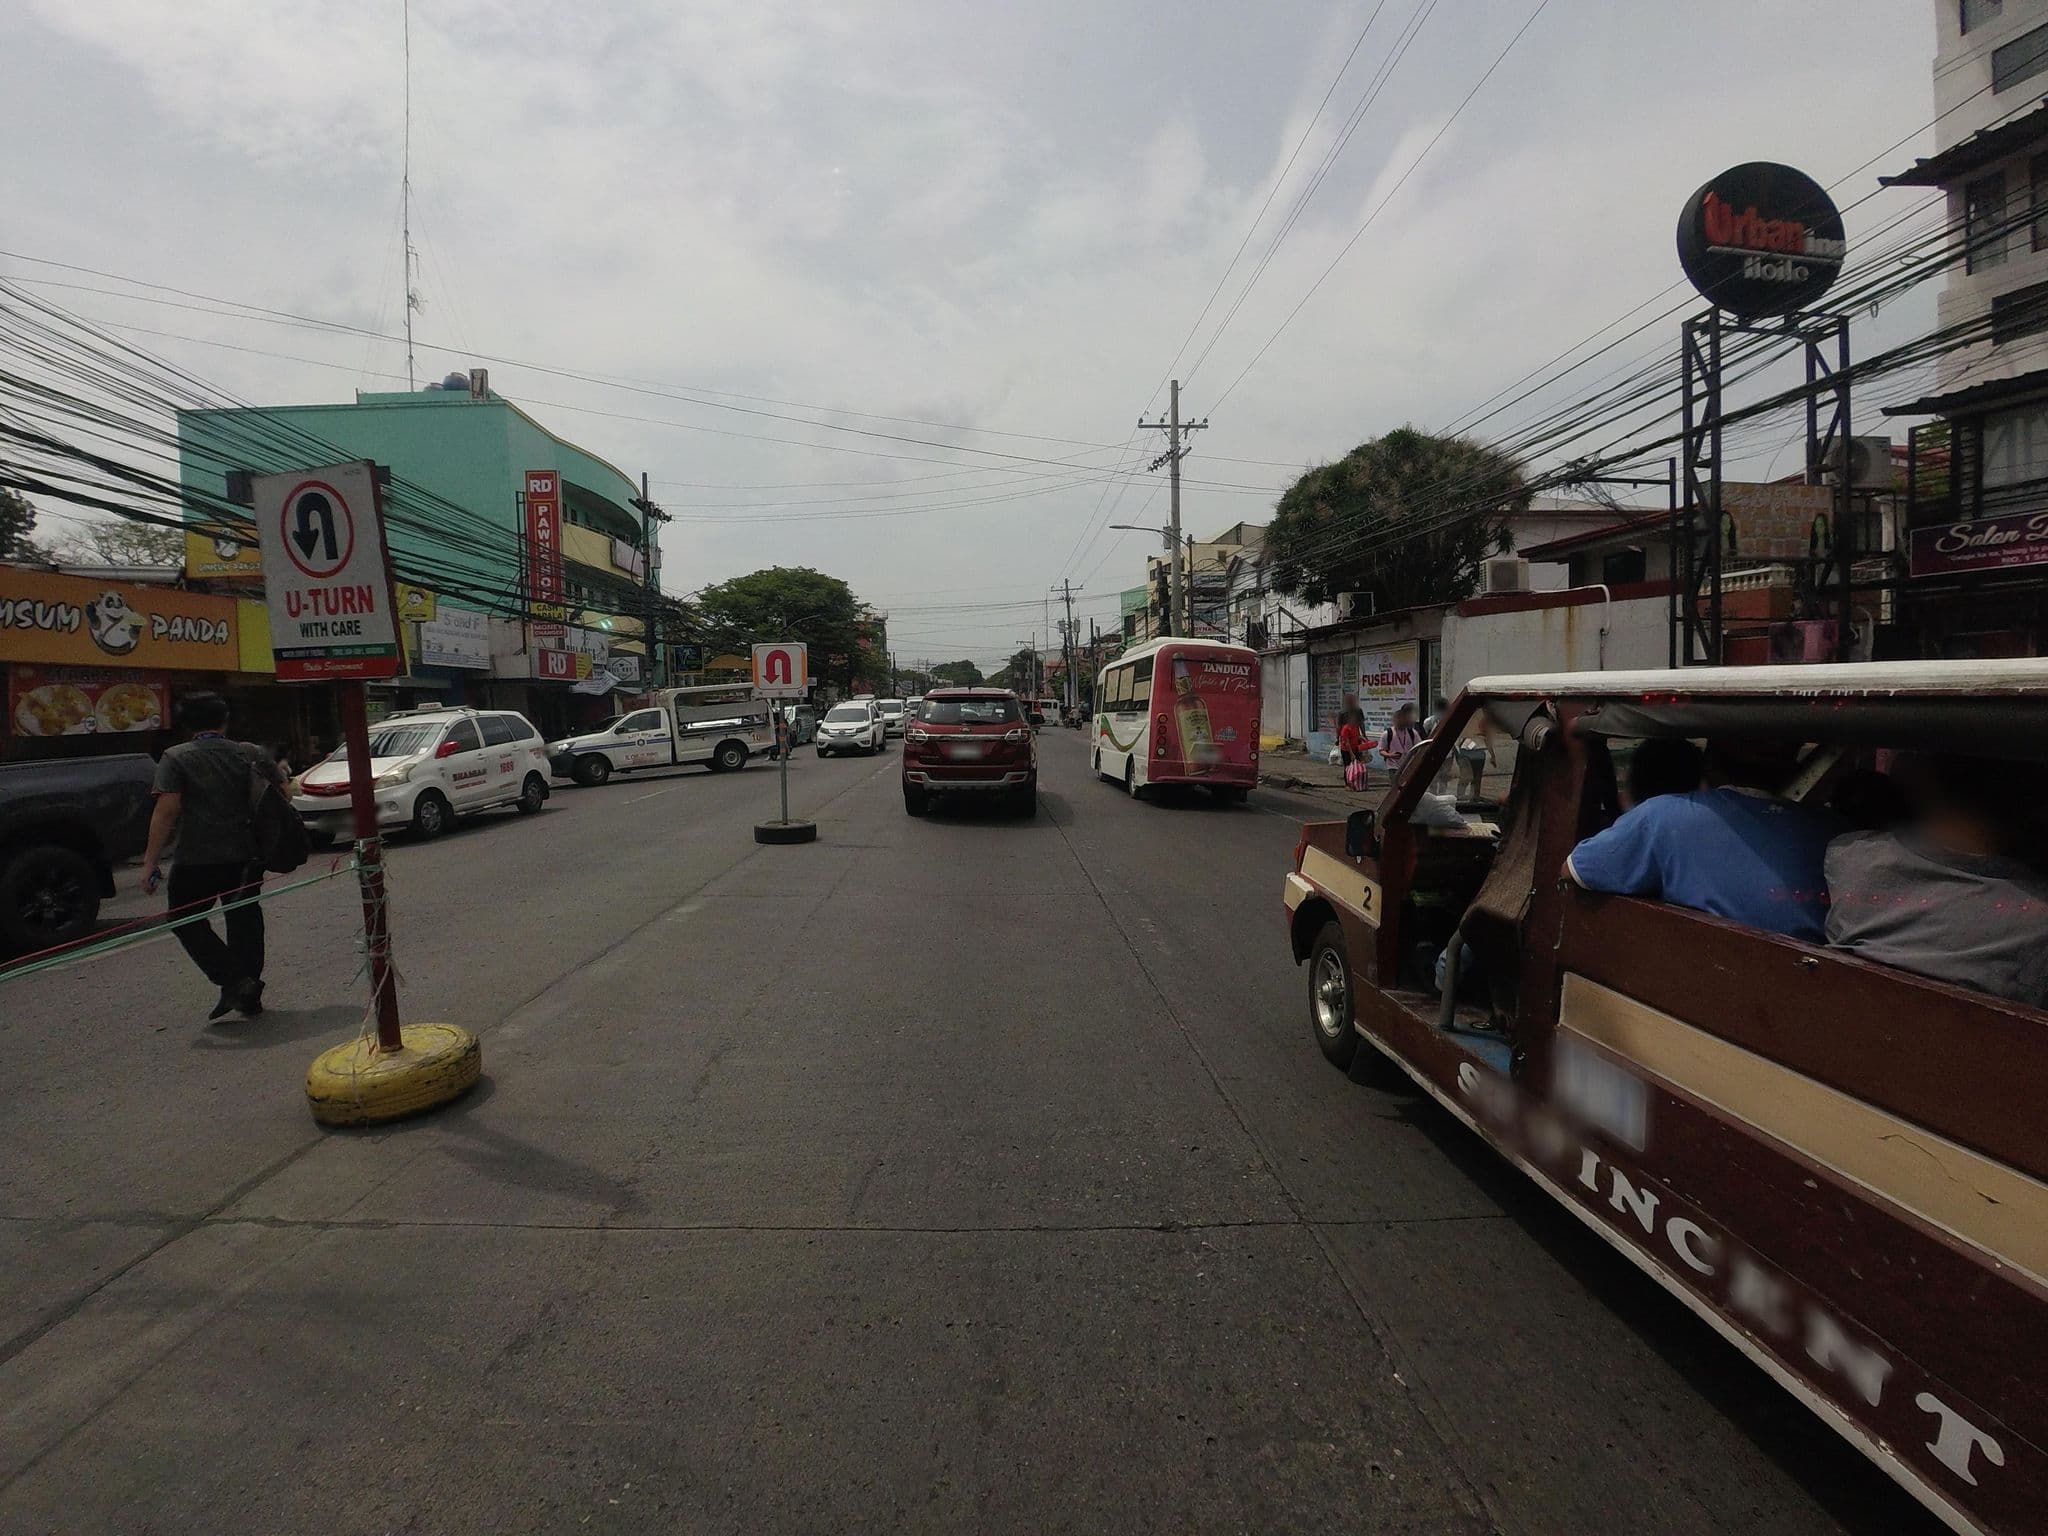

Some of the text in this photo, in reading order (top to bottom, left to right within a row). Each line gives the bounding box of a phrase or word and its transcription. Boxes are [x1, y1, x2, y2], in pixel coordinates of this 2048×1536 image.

[529, 479, 552, 493] RD
[285, 585, 375, 618] U-TURN
[151, 613, 229, 645] PANDA
[300, 620, 362, 638] WITH CARE
[548, 653, 568, 675] RD
[1202, 662, 1251, 676] TANDUAY
[1362, 671, 1412, 687] FUSELINK
[1362, 886, 1373, 911] 2
